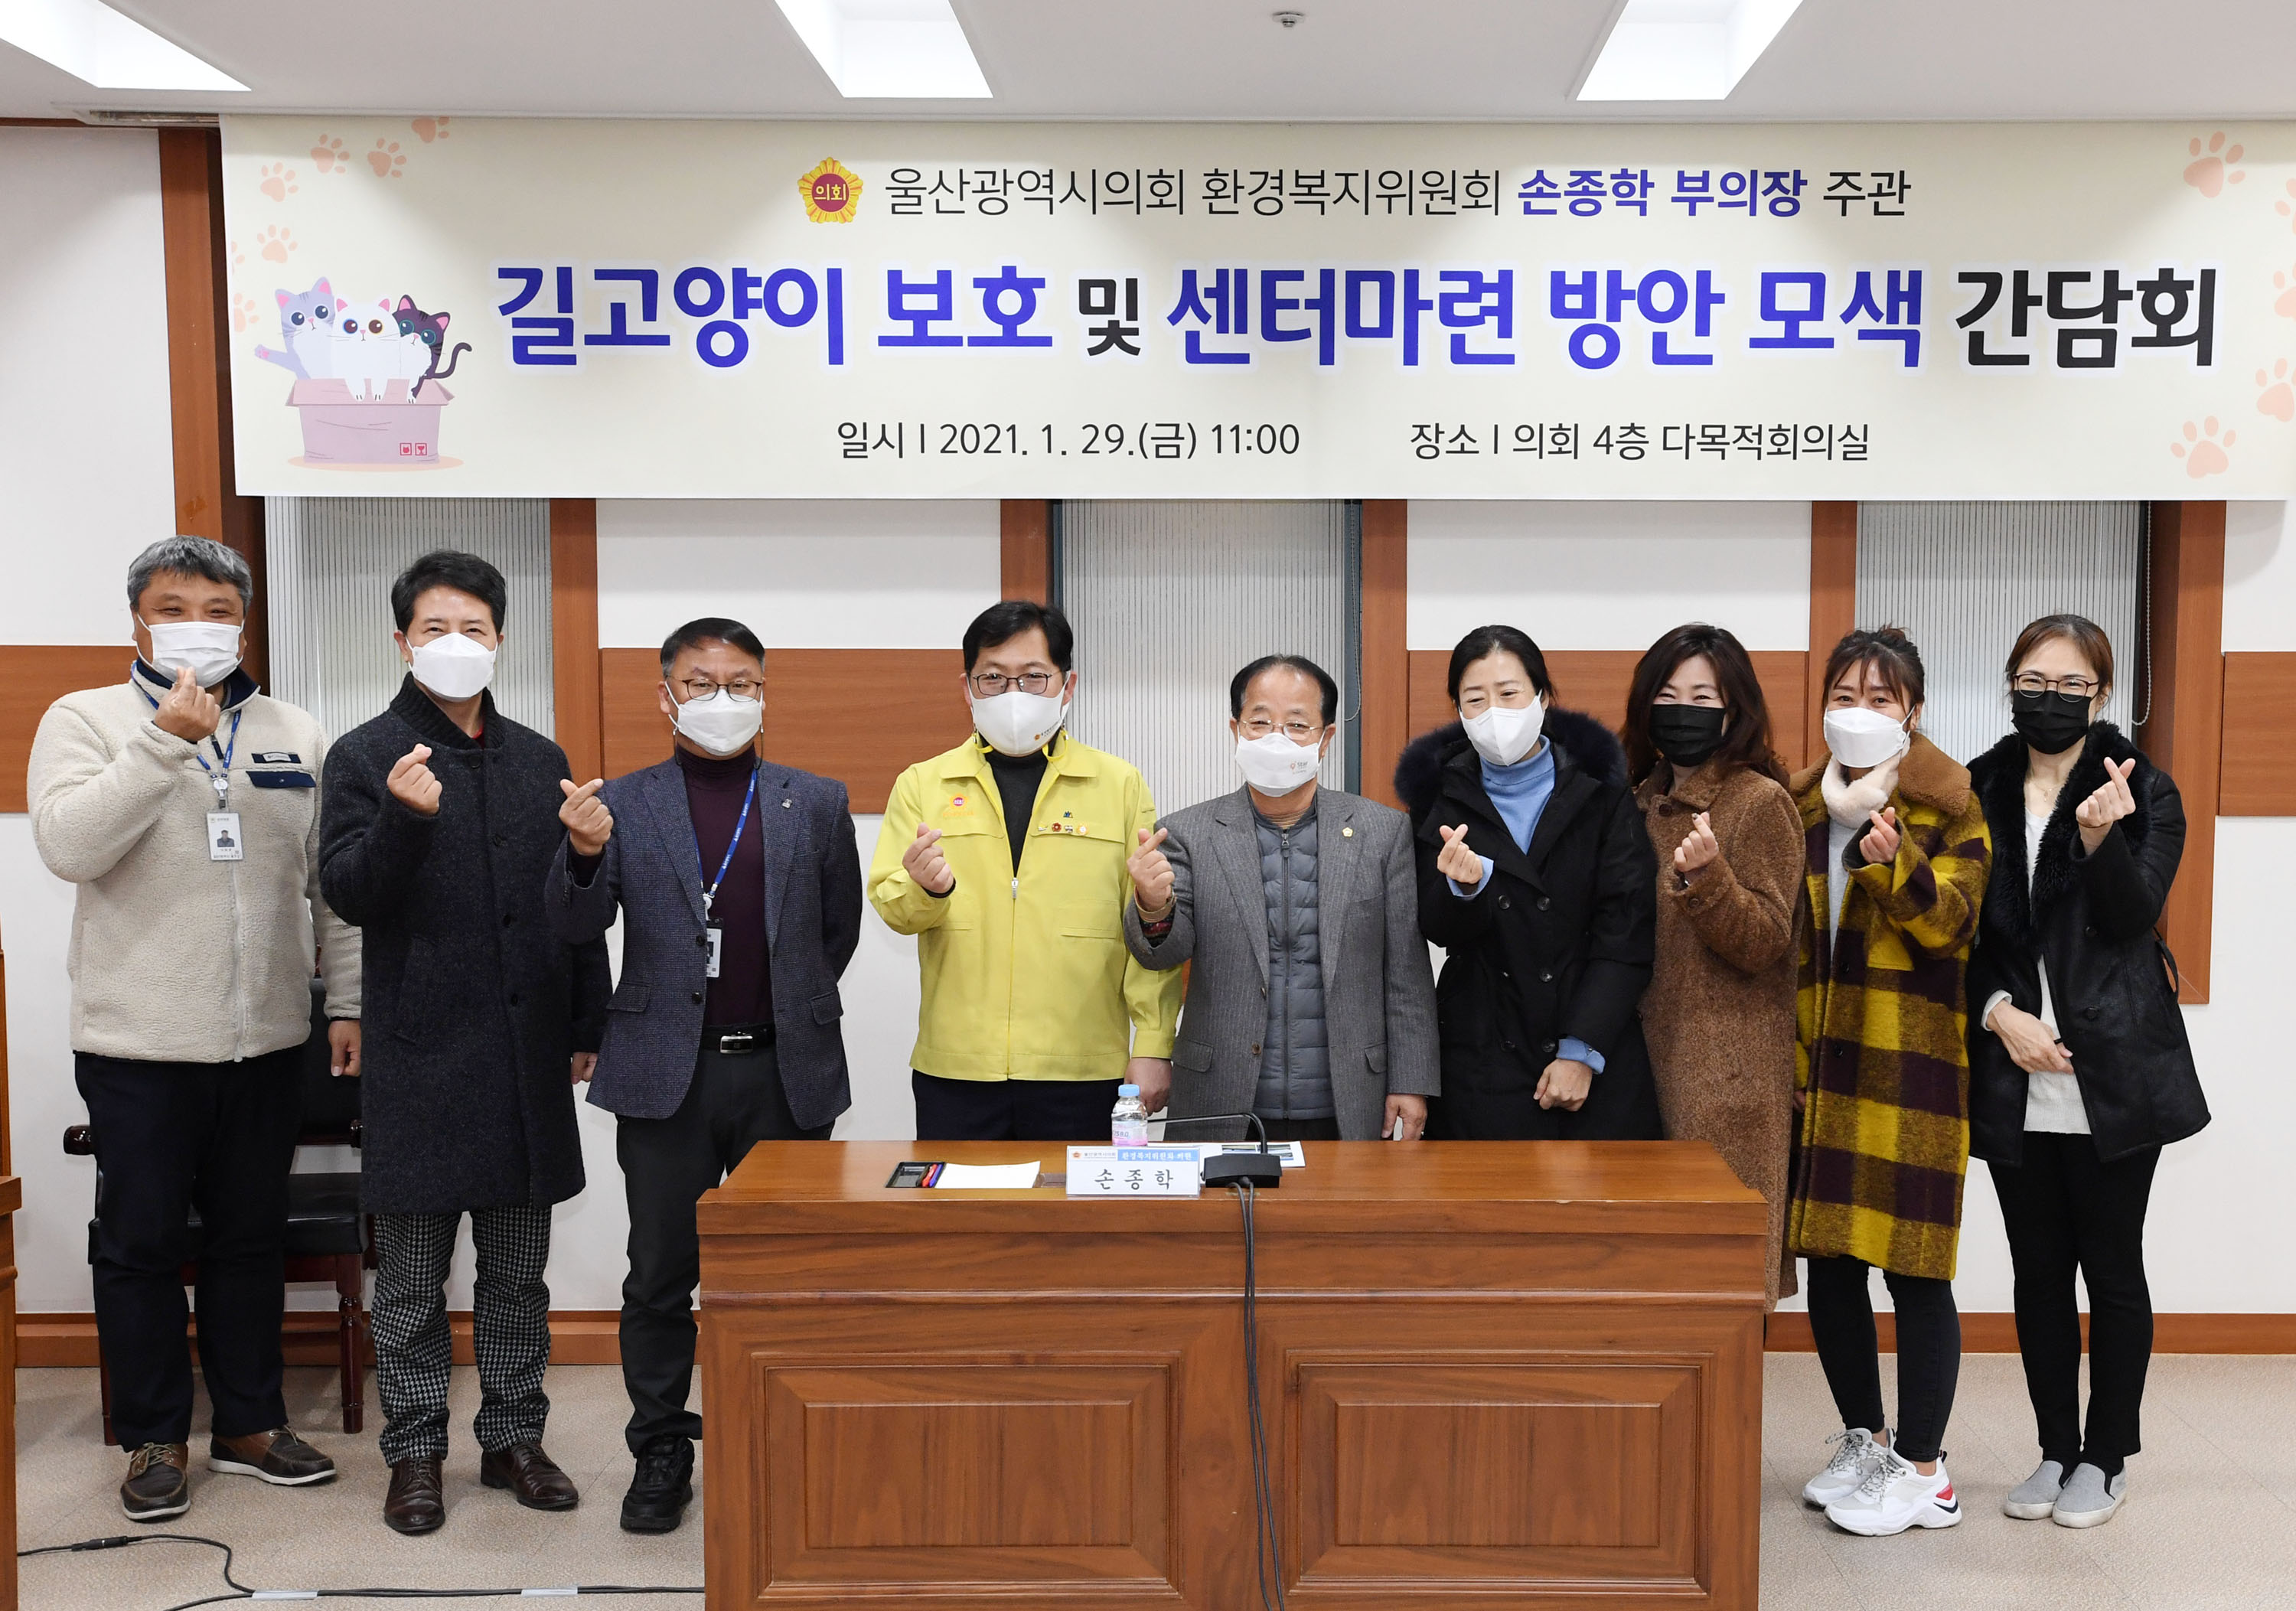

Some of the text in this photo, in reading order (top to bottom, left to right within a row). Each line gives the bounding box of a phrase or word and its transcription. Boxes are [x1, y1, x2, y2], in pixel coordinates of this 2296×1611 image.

[814, 183, 846, 201] 의회
[885, 168, 1912, 217] 울산광역시의회 환경복지위원회 손종학 부의장 주관
[497, 265, 2216, 370] 길고양이 보호 및 센터마련 방안 모색 간담회
[837, 422, 904, 459] 일시
[940, 423, 1028, 456] 2021.
[1041, 424, 1067, 456] 1.
[1081, 422, 1197, 460] 29.(금)
[1212, 423, 1300, 455] 11:00
[1411, 422, 1480, 460] 장소
[1512, 422, 1579, 460] 의회
[1593, 422, 1650, 461] 4층
[1662, 423, 1869, 461] 다목적회의실
